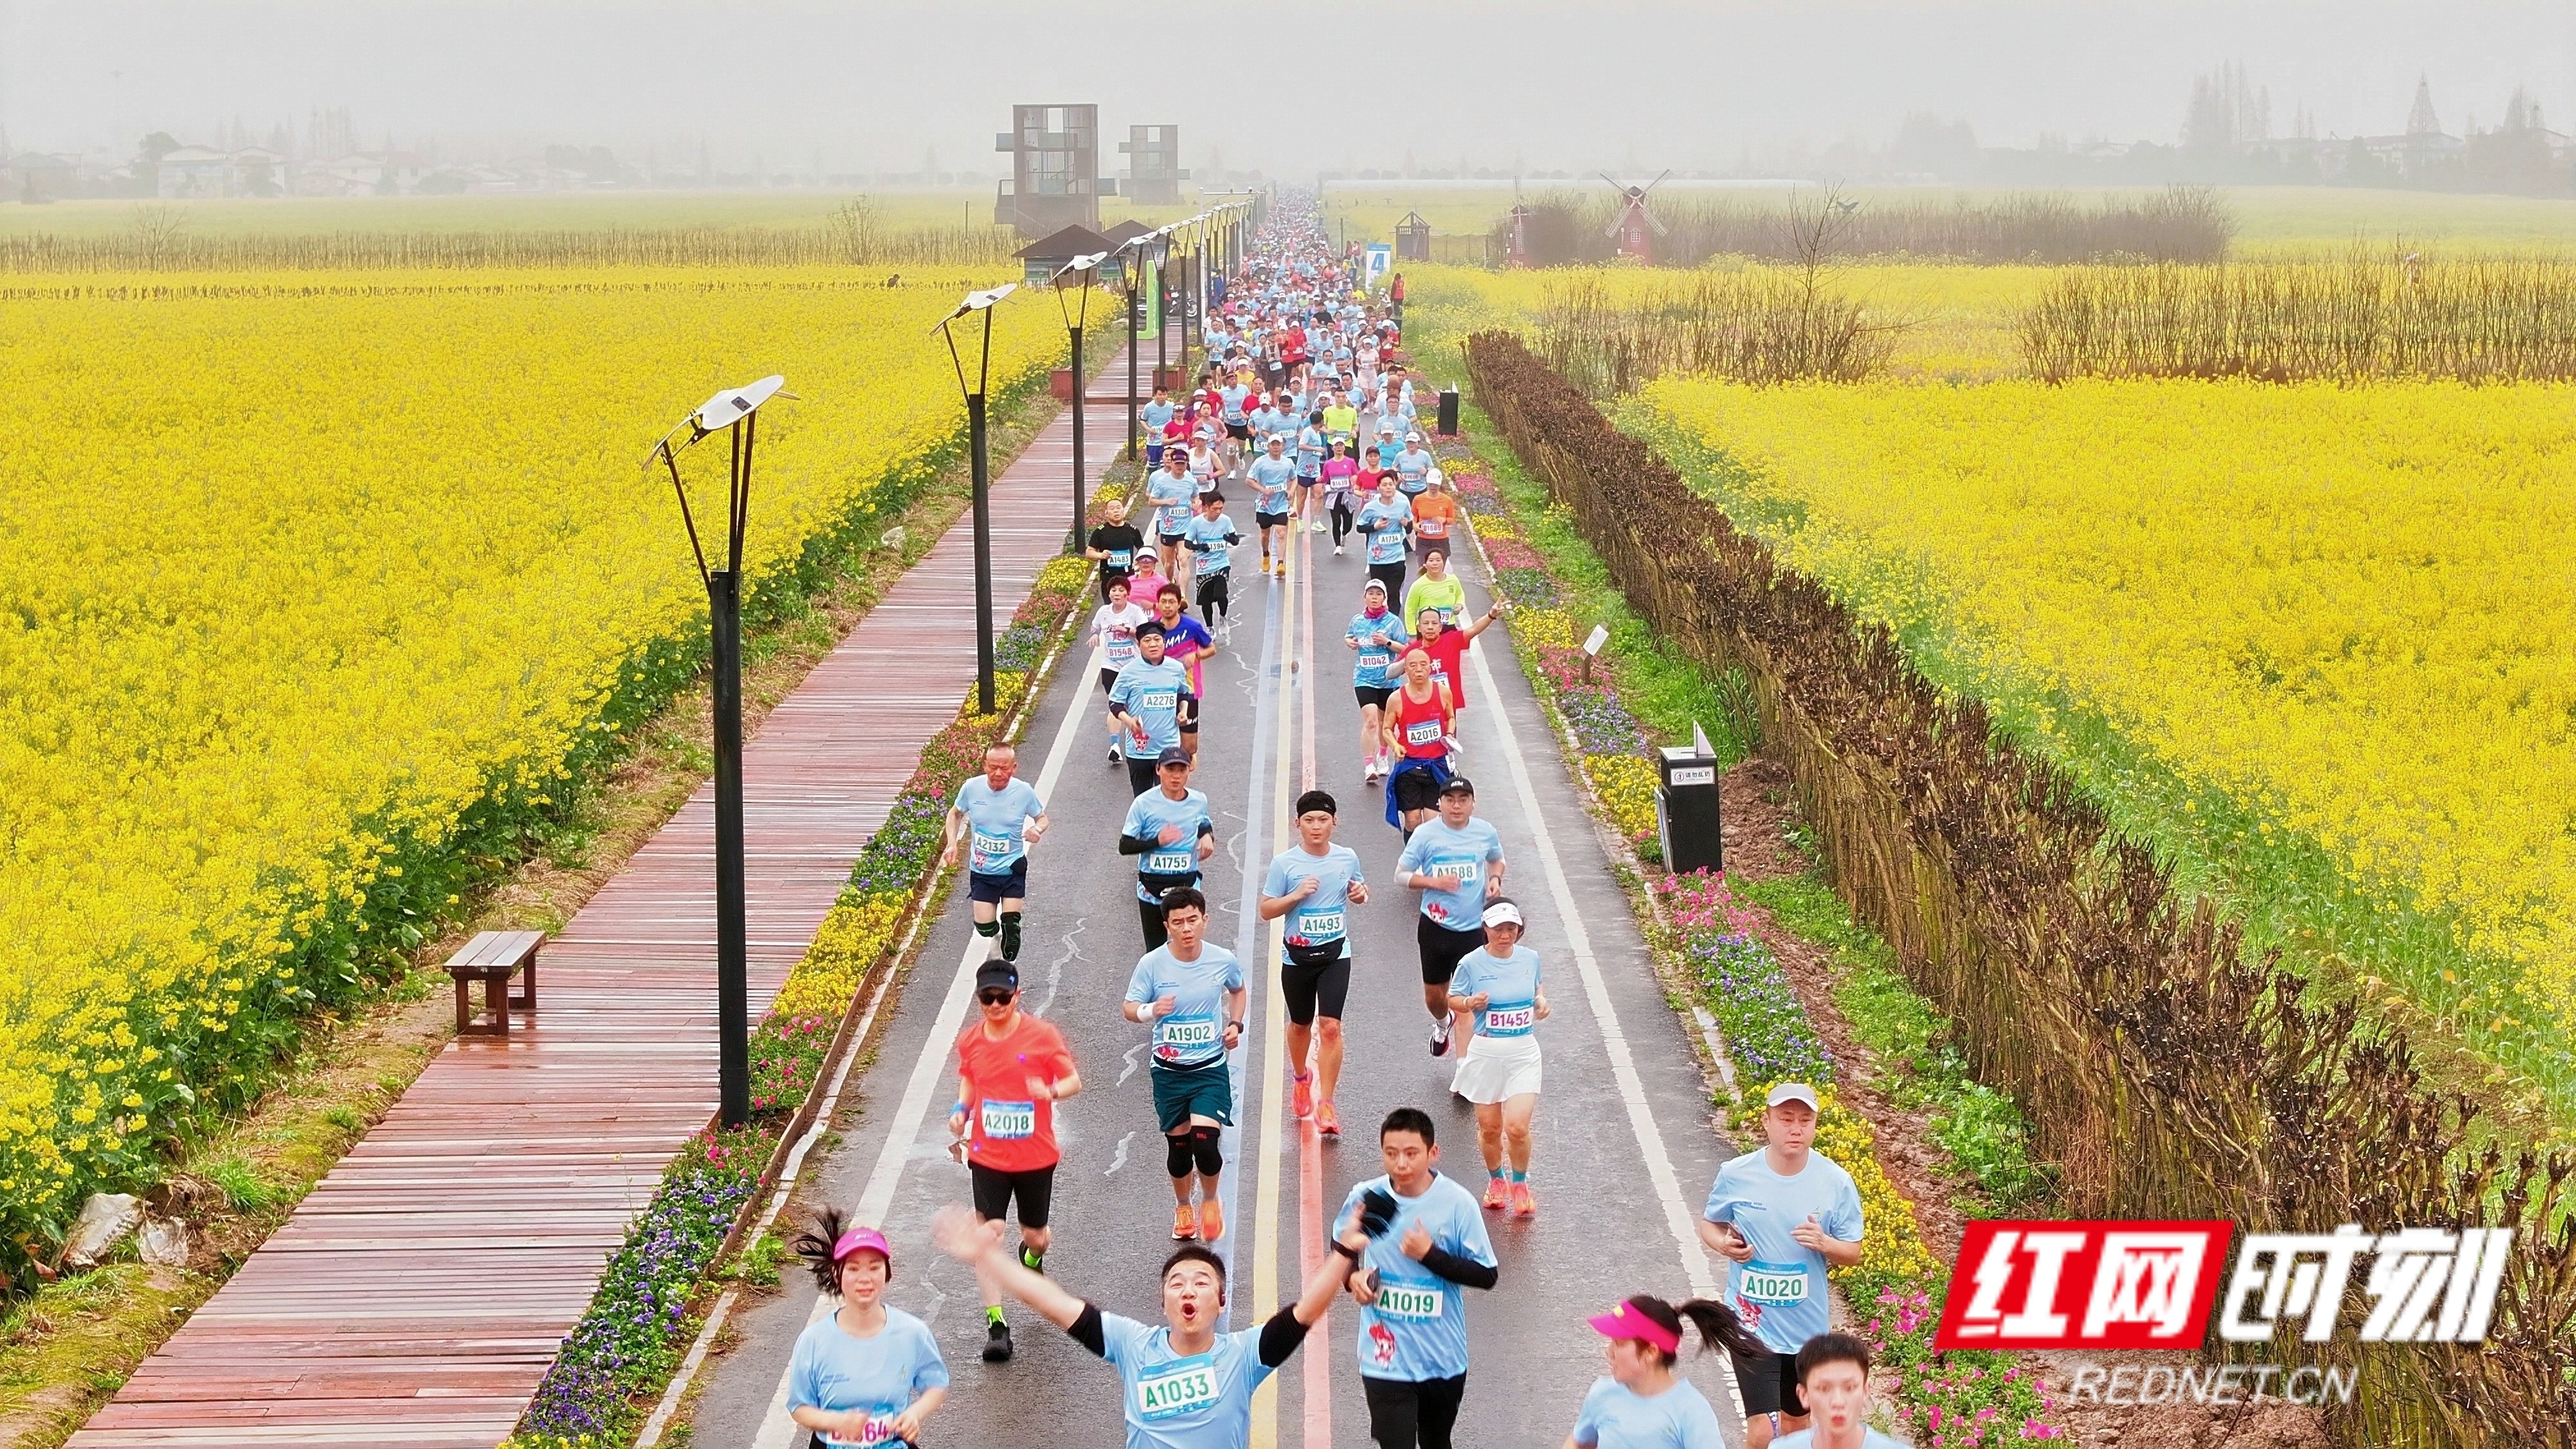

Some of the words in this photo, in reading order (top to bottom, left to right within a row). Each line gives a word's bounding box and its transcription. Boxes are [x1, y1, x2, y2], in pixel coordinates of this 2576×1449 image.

[1371, 253, 1384, 272] 4
[1381, 535, 1399, 543] A1734
[1109, 555, 1129, 564] A1483
[1109, 647, 1132, 657] B1548
[1362, 656, 1387, 665] B1042
[1146, 695, 1175, 706] A2276
[1410, 727, 1439, 741] A2016
[976, 837, 1006, 852] A2132
[1153, 856, 1188, 869] A1755
[1437, 865, 1473, 878] A1688
[1304, 917, 1341, 932] A1493
[1490, 1011, 1530, 1027] B1452
[1167, 1025, 1211, 1041] A1902
[985, 1113, 1029, 1131] A2018
[1745, 1275, 1802, 1296] A1020
[1379, 1289, 1434, 1313] A1019
[1146, 1373, 1209, 1408] A1033
